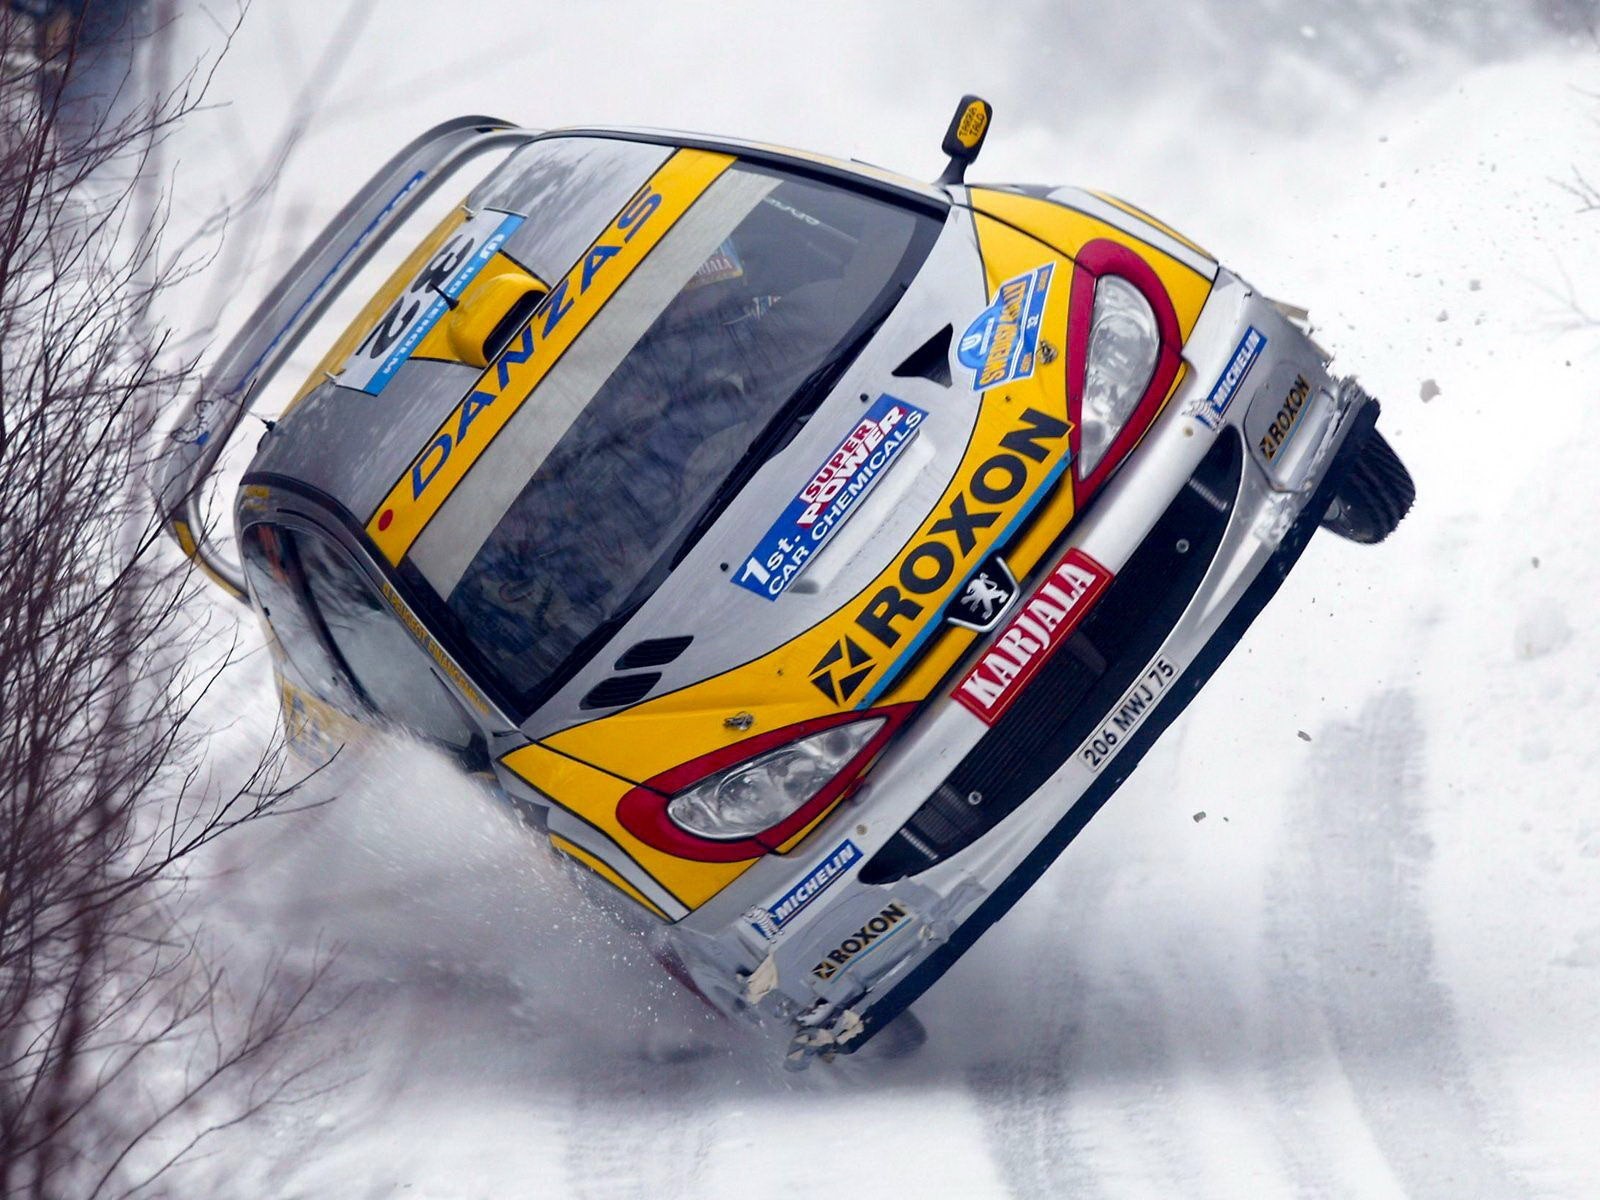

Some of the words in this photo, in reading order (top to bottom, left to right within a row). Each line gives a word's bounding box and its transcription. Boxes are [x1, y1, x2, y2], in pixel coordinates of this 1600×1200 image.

[356, 234, 474, 359] 32
[411, 185, 664, 500] DANZAS
[1213, 330, 1261, 408] MICHELIN
[1268, 374, 1310, 446] ROXON
[768, 546, 809, 595] CAR
[811, 410, 923, 541] CHEMICALS
[797, 405, 906, 529] POWER
[804, 423, 874, 498] SUPER
[855, 407, 1072, 650] ROXON
[962, 563, 1097, 711] KARJALA
[1084, 726, 1119, 767] 206
[1112, 685, 1155, 734] MWJ
[1149, 659, 1175, 688] 75
[774, 843, 856, 922] MICHELIN
[827, 902, 906, 965] ROXON
